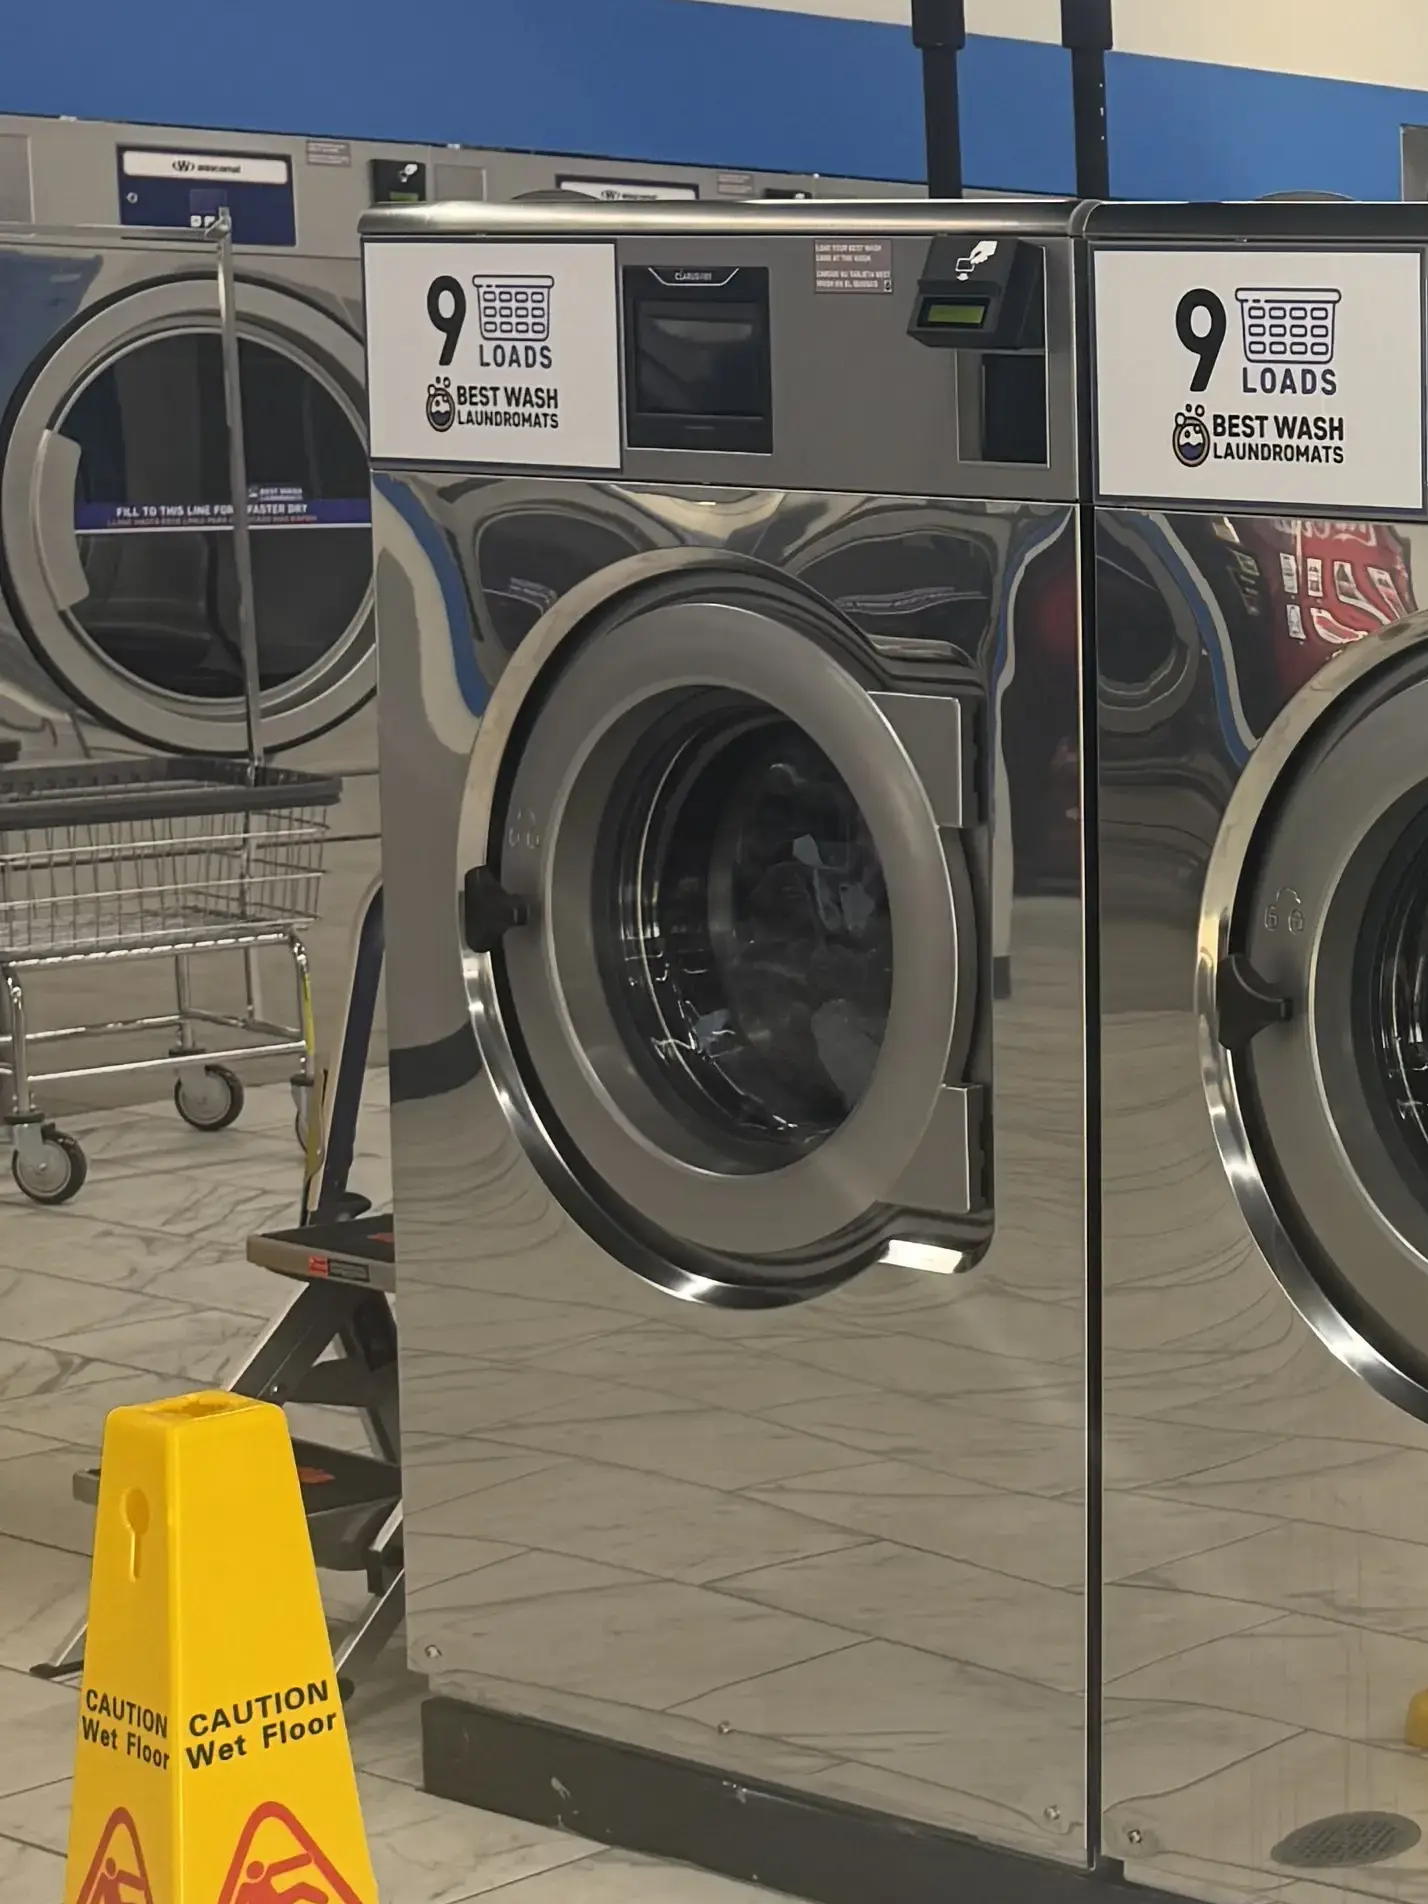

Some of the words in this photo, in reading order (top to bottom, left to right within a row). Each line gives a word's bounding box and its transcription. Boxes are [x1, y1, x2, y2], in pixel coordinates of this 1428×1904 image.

[427, 275, 467, 366] 9
[1175, 288, 1227, 392] 9
[479, 344, 553, 369] LOADS
[1242, 367, 1337, 396] LOADS
[456, 385, 500, 407] BEST
[504, 386, 559, 409] WASH
[457, 409, 559, 430] LAUNDROMATS
[1212, 414, 1268, 438] BEST
[1273, 415, 1344, 441] WASH
[1213, 442, 1344, 464] LAUNDROMATS
[116, 507, 140, 517] FILL
[142, 506, 157, 516] TO
[160, 505, 184, 516] THIS
[187, 505, 211, 516] LINE
[247, 503, 285, 515] FASTER
[86, 1688, 168, 1739] CAUTION
[189, 1680, 329, 1737] CAUTION
[82, 1715, 118, 1751] Wet
[127, 1731, 171, 1771] Floor
[186, 1734, 248, 1770] Wet
[262, 1712, 337, 1749] Floor
